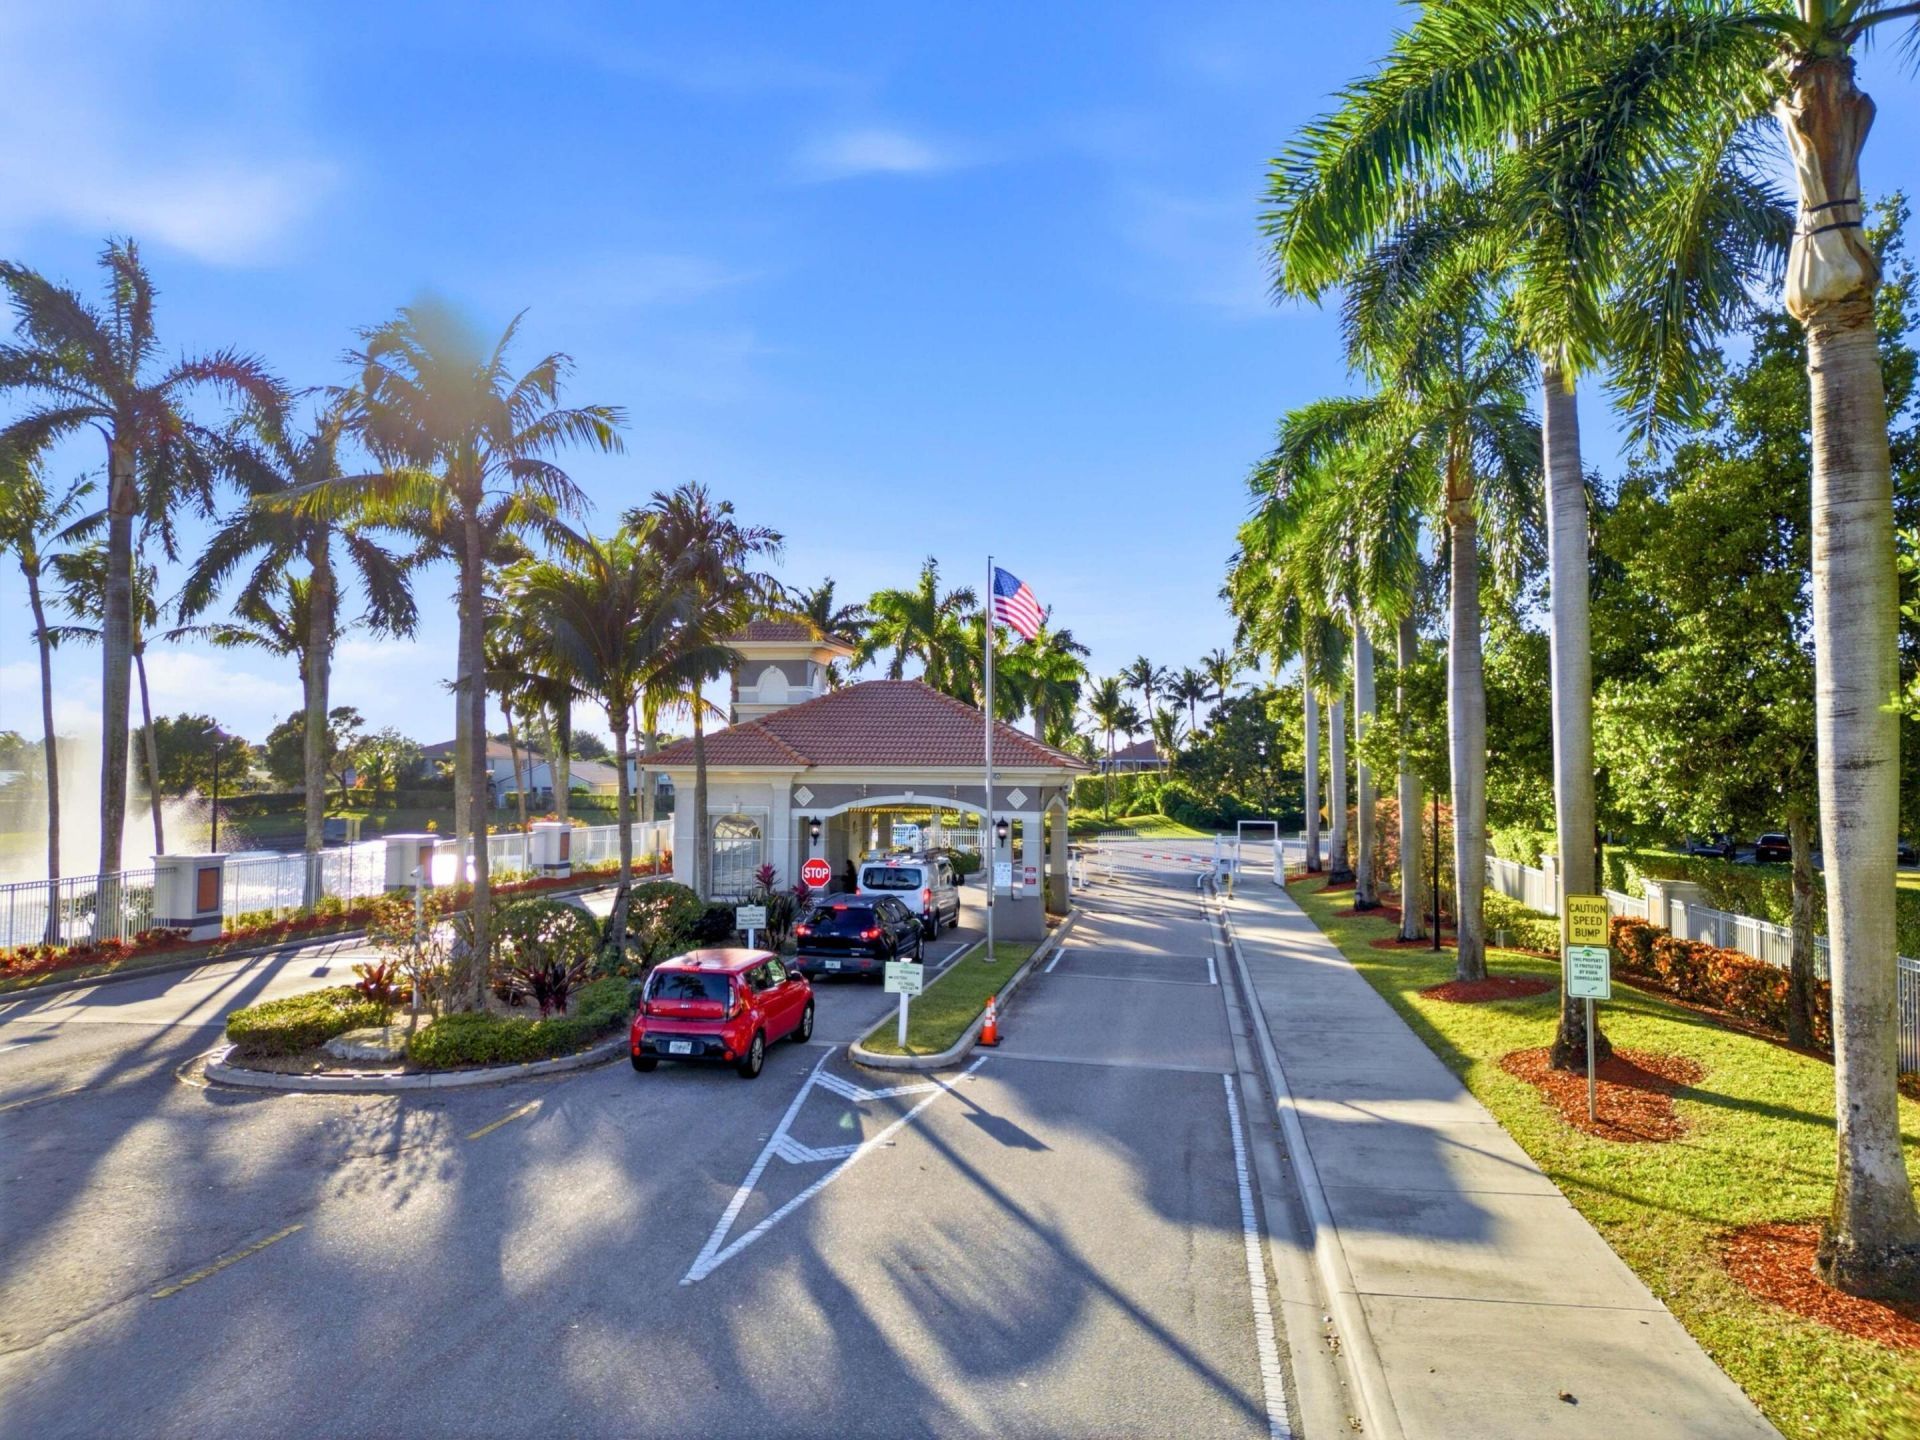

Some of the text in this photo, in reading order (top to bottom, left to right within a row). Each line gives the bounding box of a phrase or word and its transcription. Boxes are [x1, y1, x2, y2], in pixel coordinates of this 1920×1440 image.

[804, 867, 829, 879] STOP
[1569, 903, 1606, 914] CAUTION
[1573, 915, 1602, 926] SPEED
[1575, 927, 1600, 937] BUMP
